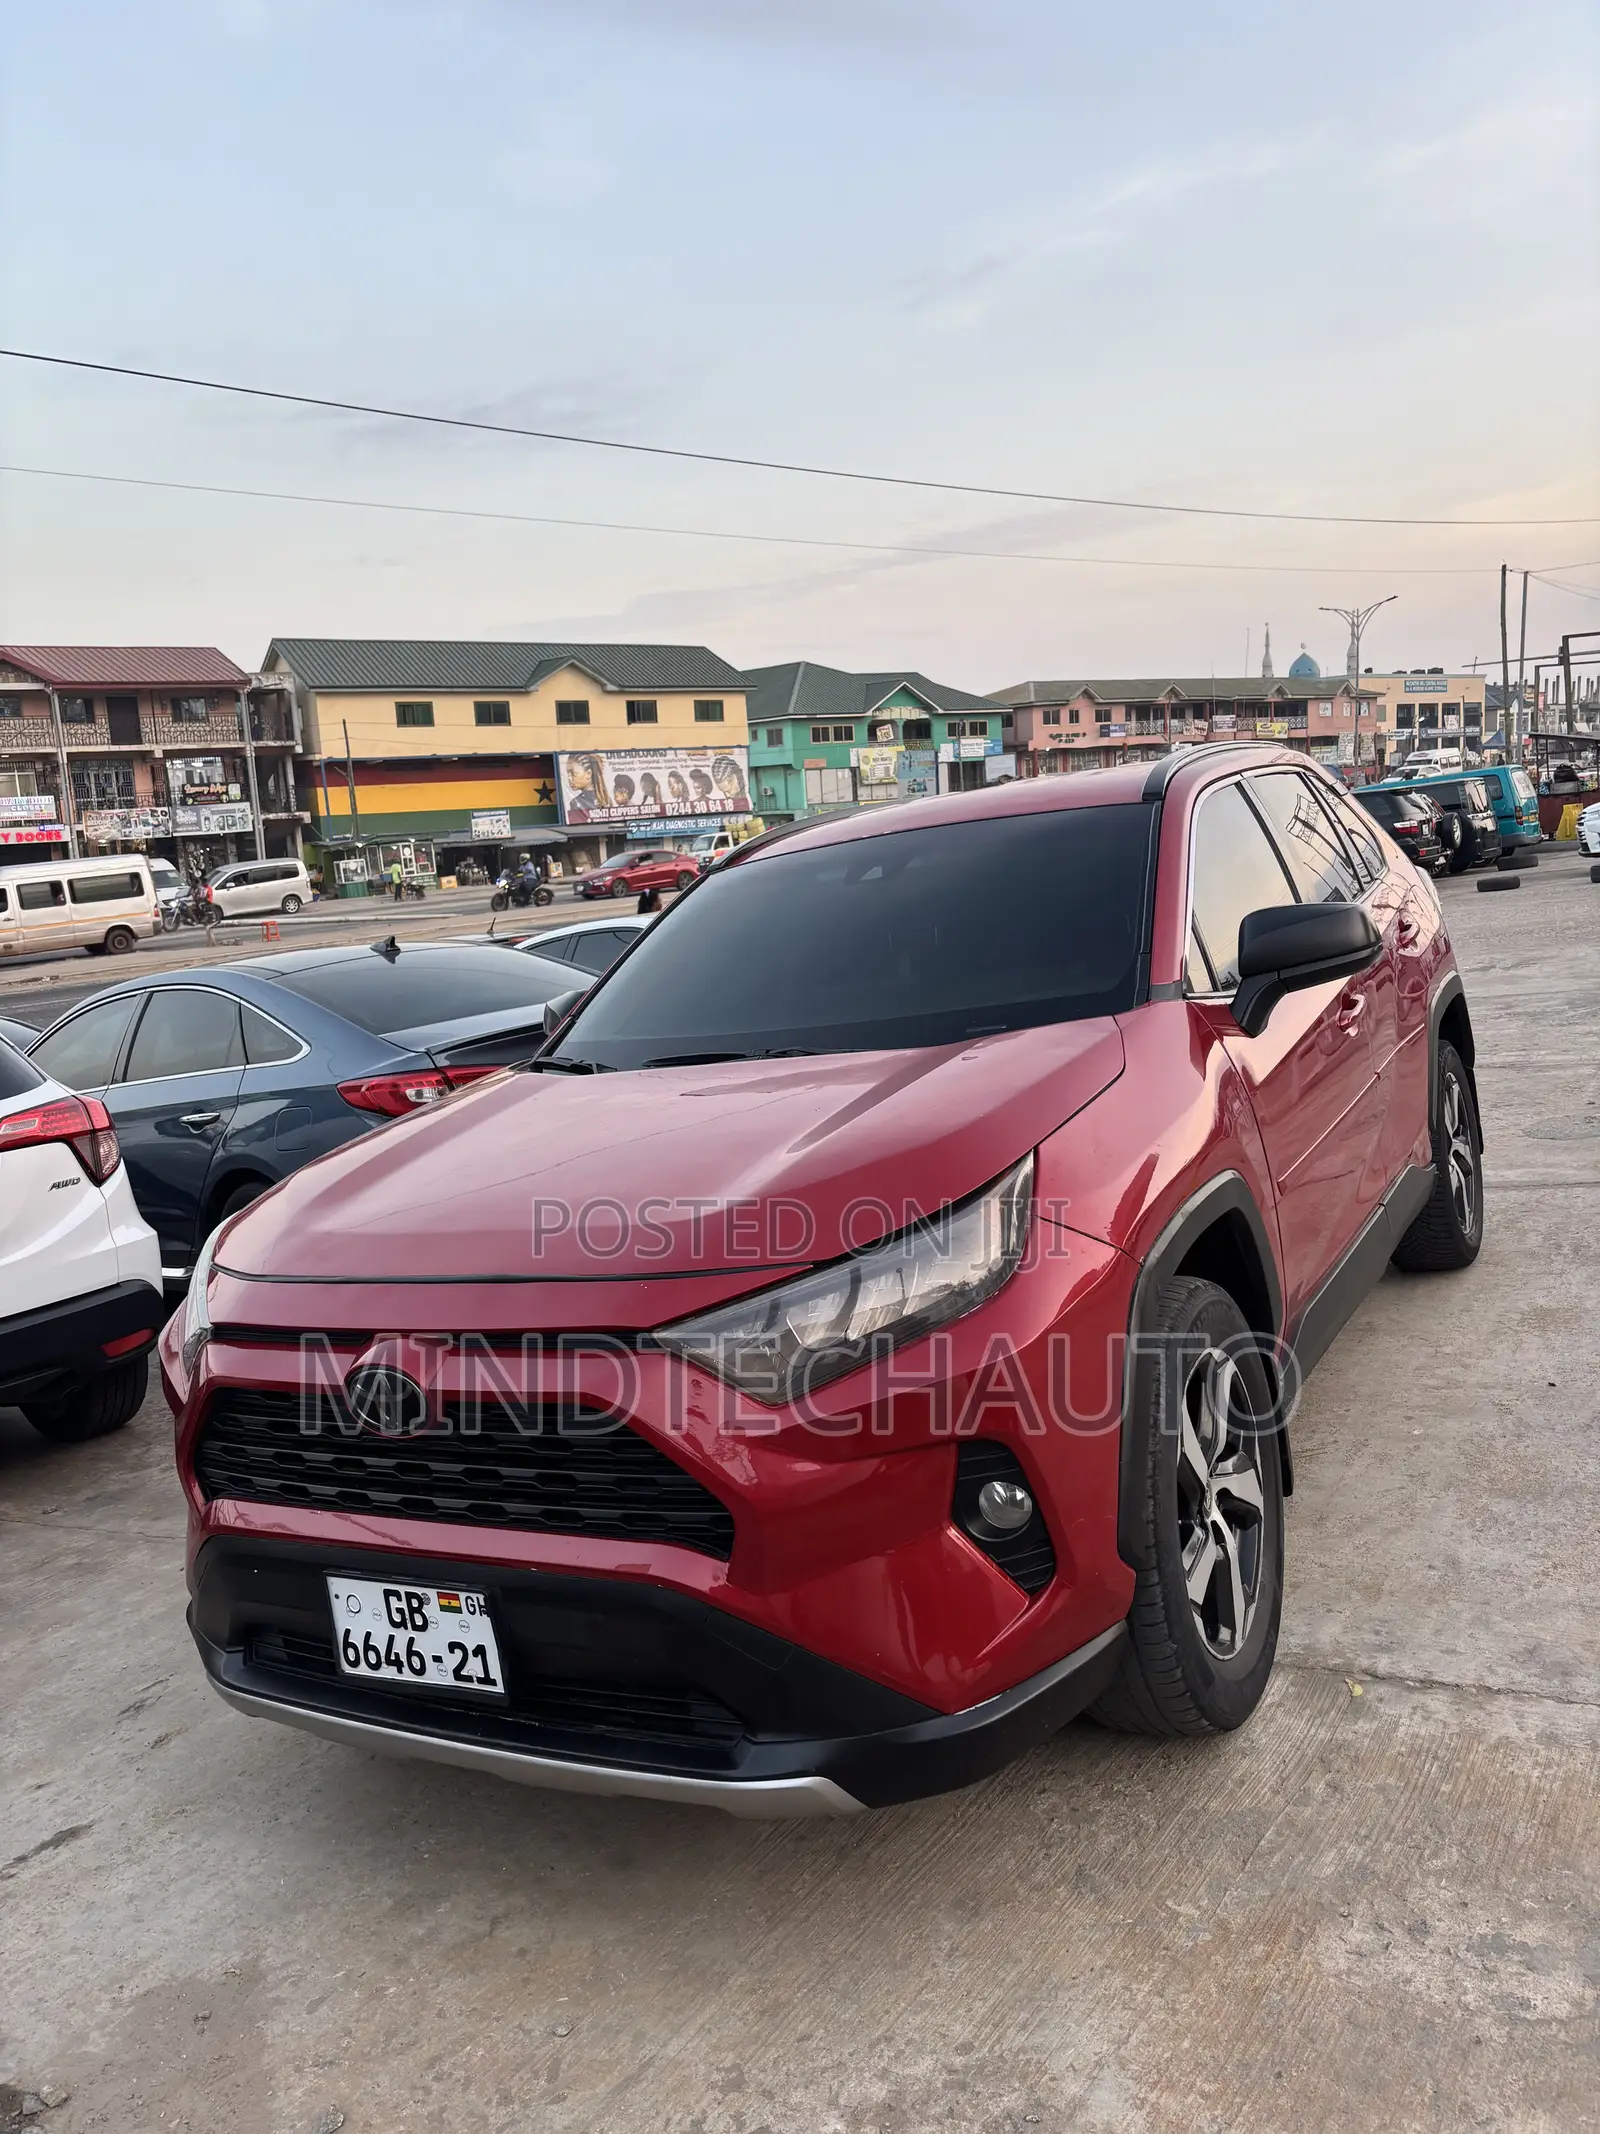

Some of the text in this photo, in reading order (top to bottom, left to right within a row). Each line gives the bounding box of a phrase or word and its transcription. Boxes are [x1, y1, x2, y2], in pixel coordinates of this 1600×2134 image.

[610, 806, 639, 817] CLIPPERS
[640, 804, 660, 814] SALON
[665, 799, 734, 816] 0244 30 64 18
[666, 819, 696, 830] DIAGNOSTIC
[697, 817, 721, 828] SERVICES
[15, 830, 62, 843] DOORS
[48, 1177, 81, 1192] AWD
[383, 1588, 489, 1632] GB GH
[342, 1628, 497, 1686] 6646-21
